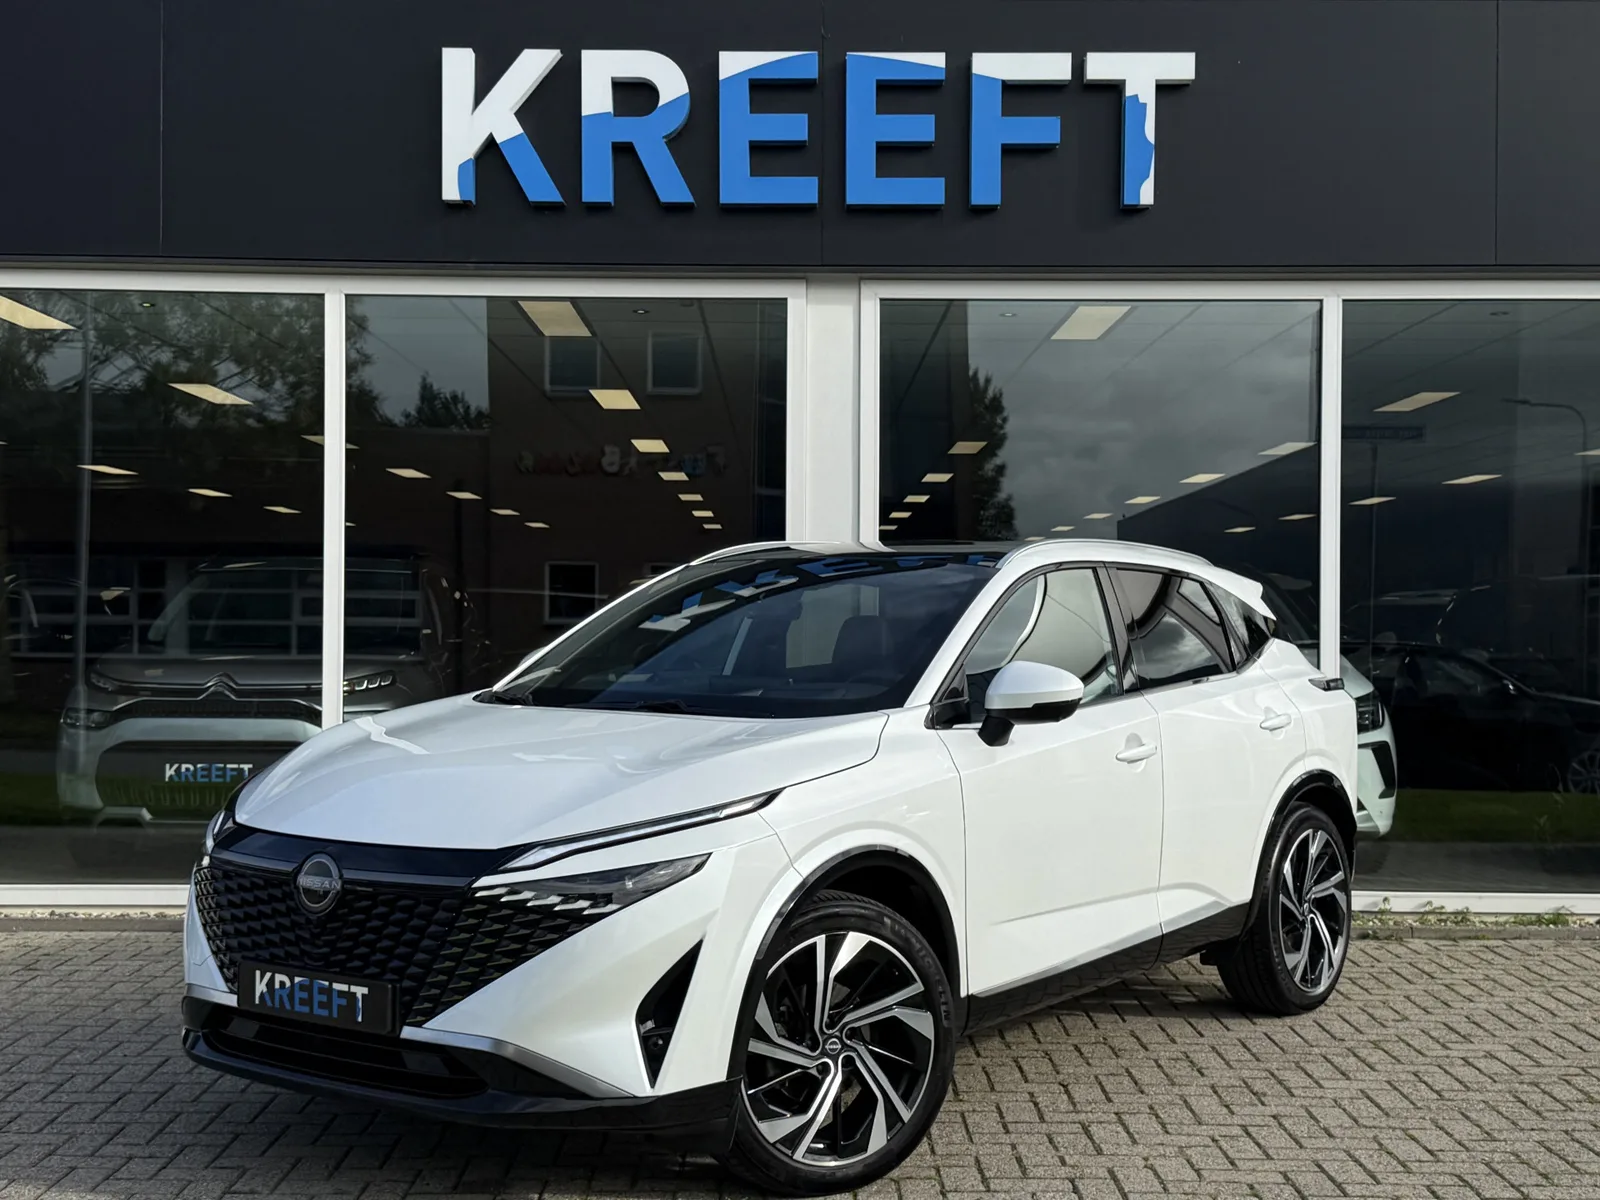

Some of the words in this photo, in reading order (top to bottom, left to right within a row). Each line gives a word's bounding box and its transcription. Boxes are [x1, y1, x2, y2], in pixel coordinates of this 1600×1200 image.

[441, 46, 1196, 209] KREEFT
[165, 763, 253, 782] KREEFT
[296, 871, 341, 890] NISSAN
[255, 970, 369, 1023] KREEFT
